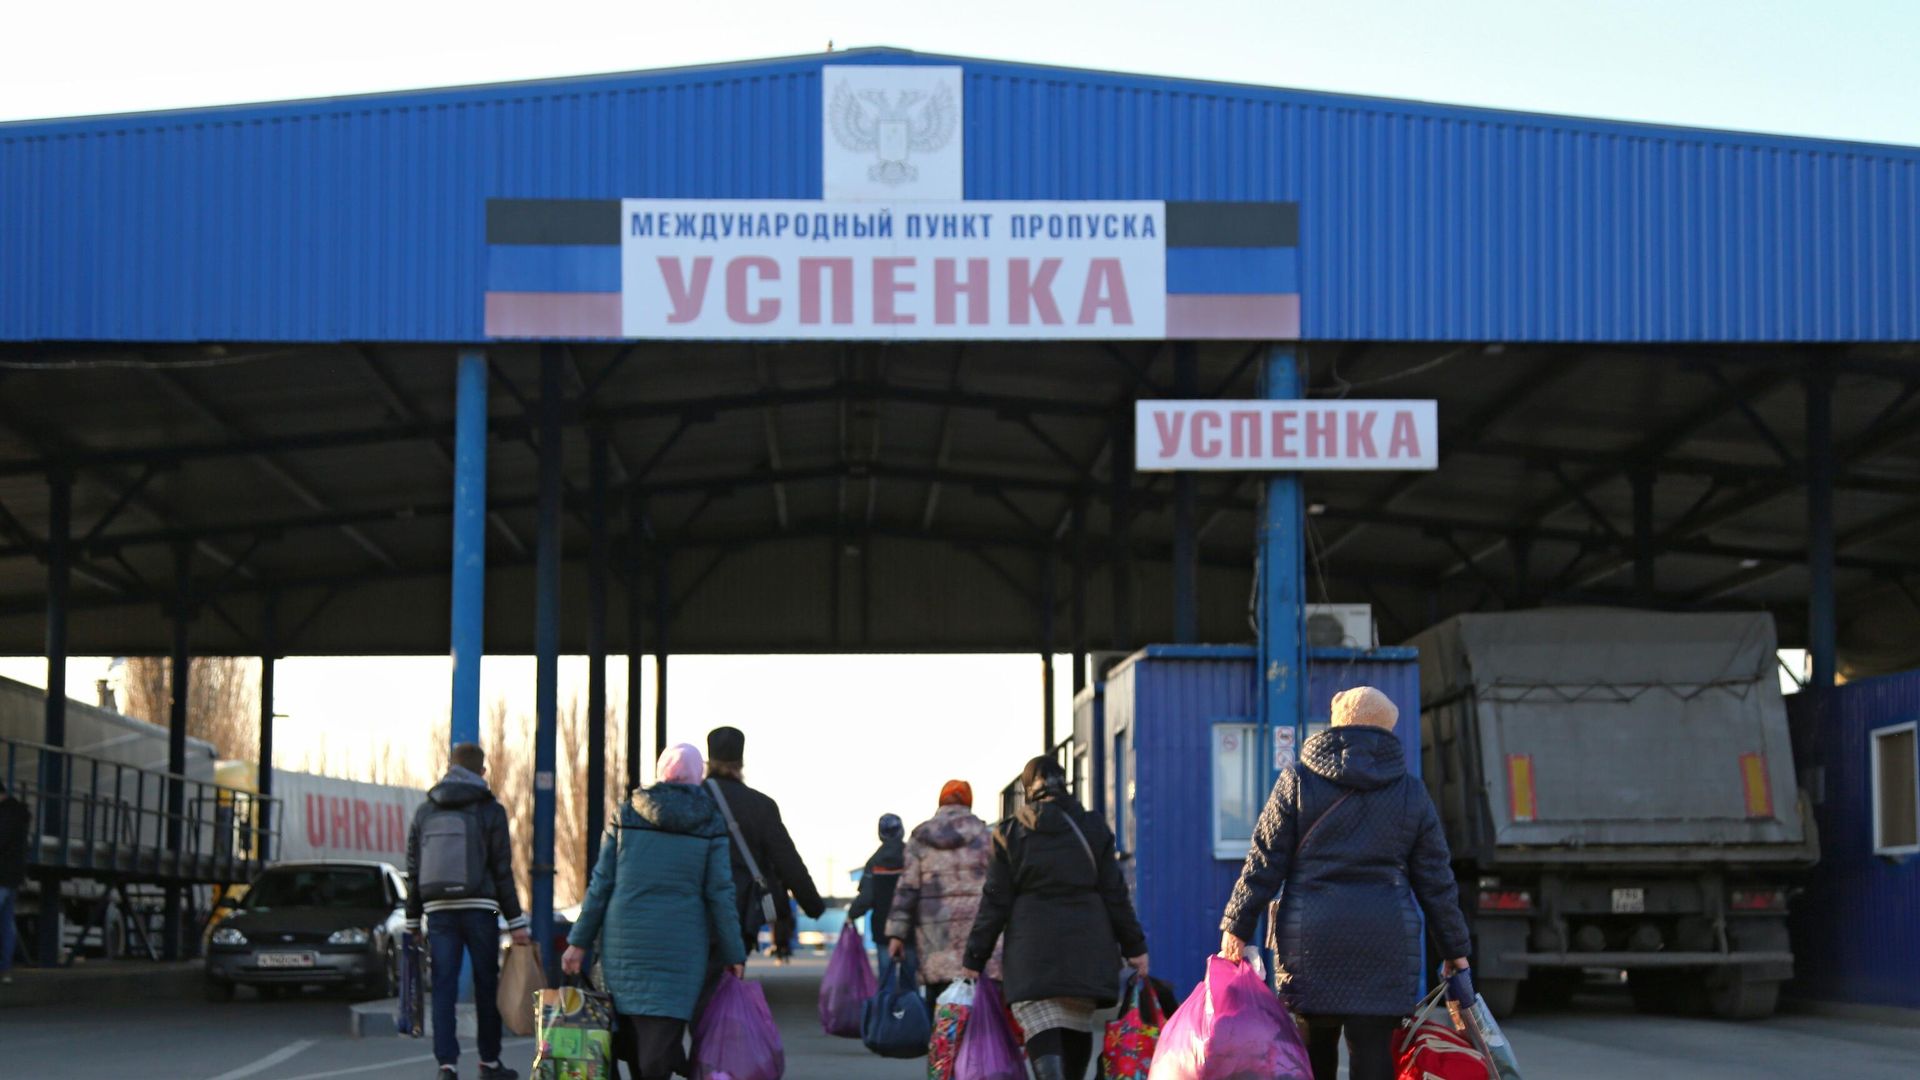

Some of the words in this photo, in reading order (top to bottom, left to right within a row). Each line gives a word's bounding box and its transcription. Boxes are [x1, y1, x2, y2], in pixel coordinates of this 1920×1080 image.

[630, 208, 893, 241] МЕЖДУНАРОДНЫЙ
[906, 213, 992, 239] ПУНКТ
[1010, 214, 1157, 240] ПРОПУСКА
[656, 255, 1135, 325] УСПЕНКА
[1153, 409, 1421, 459] УСПЕНКА
